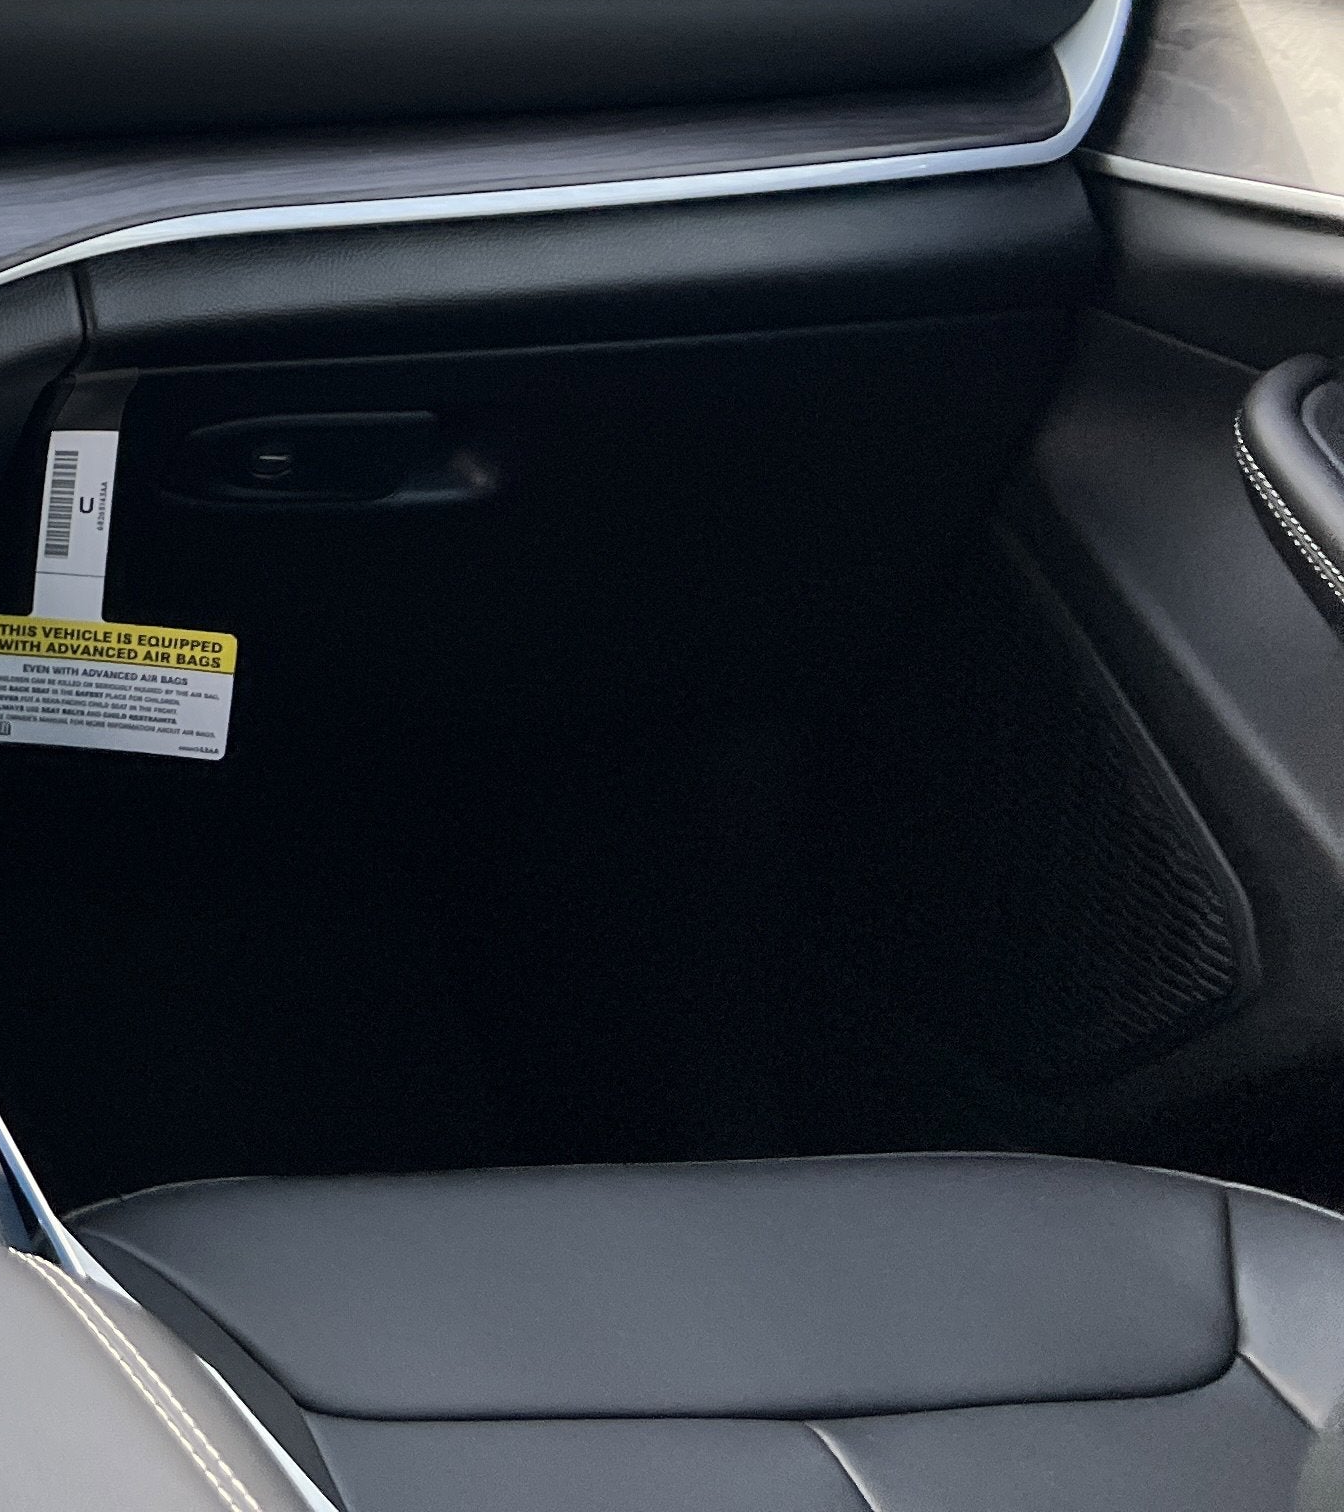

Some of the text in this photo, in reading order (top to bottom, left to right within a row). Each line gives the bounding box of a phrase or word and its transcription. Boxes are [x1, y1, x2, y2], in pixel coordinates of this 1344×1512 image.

[0, 624, 223, 654] THIS VEHICLE IS EQUIPPED
[45, 641, 138, 660] ADVANCED
[143, 650, 171, 664] AIR
[176, 653, 221, 669] BAGS
[23, 664, 188, 686] EVEN WITH ADVANCED AIR BAGS
